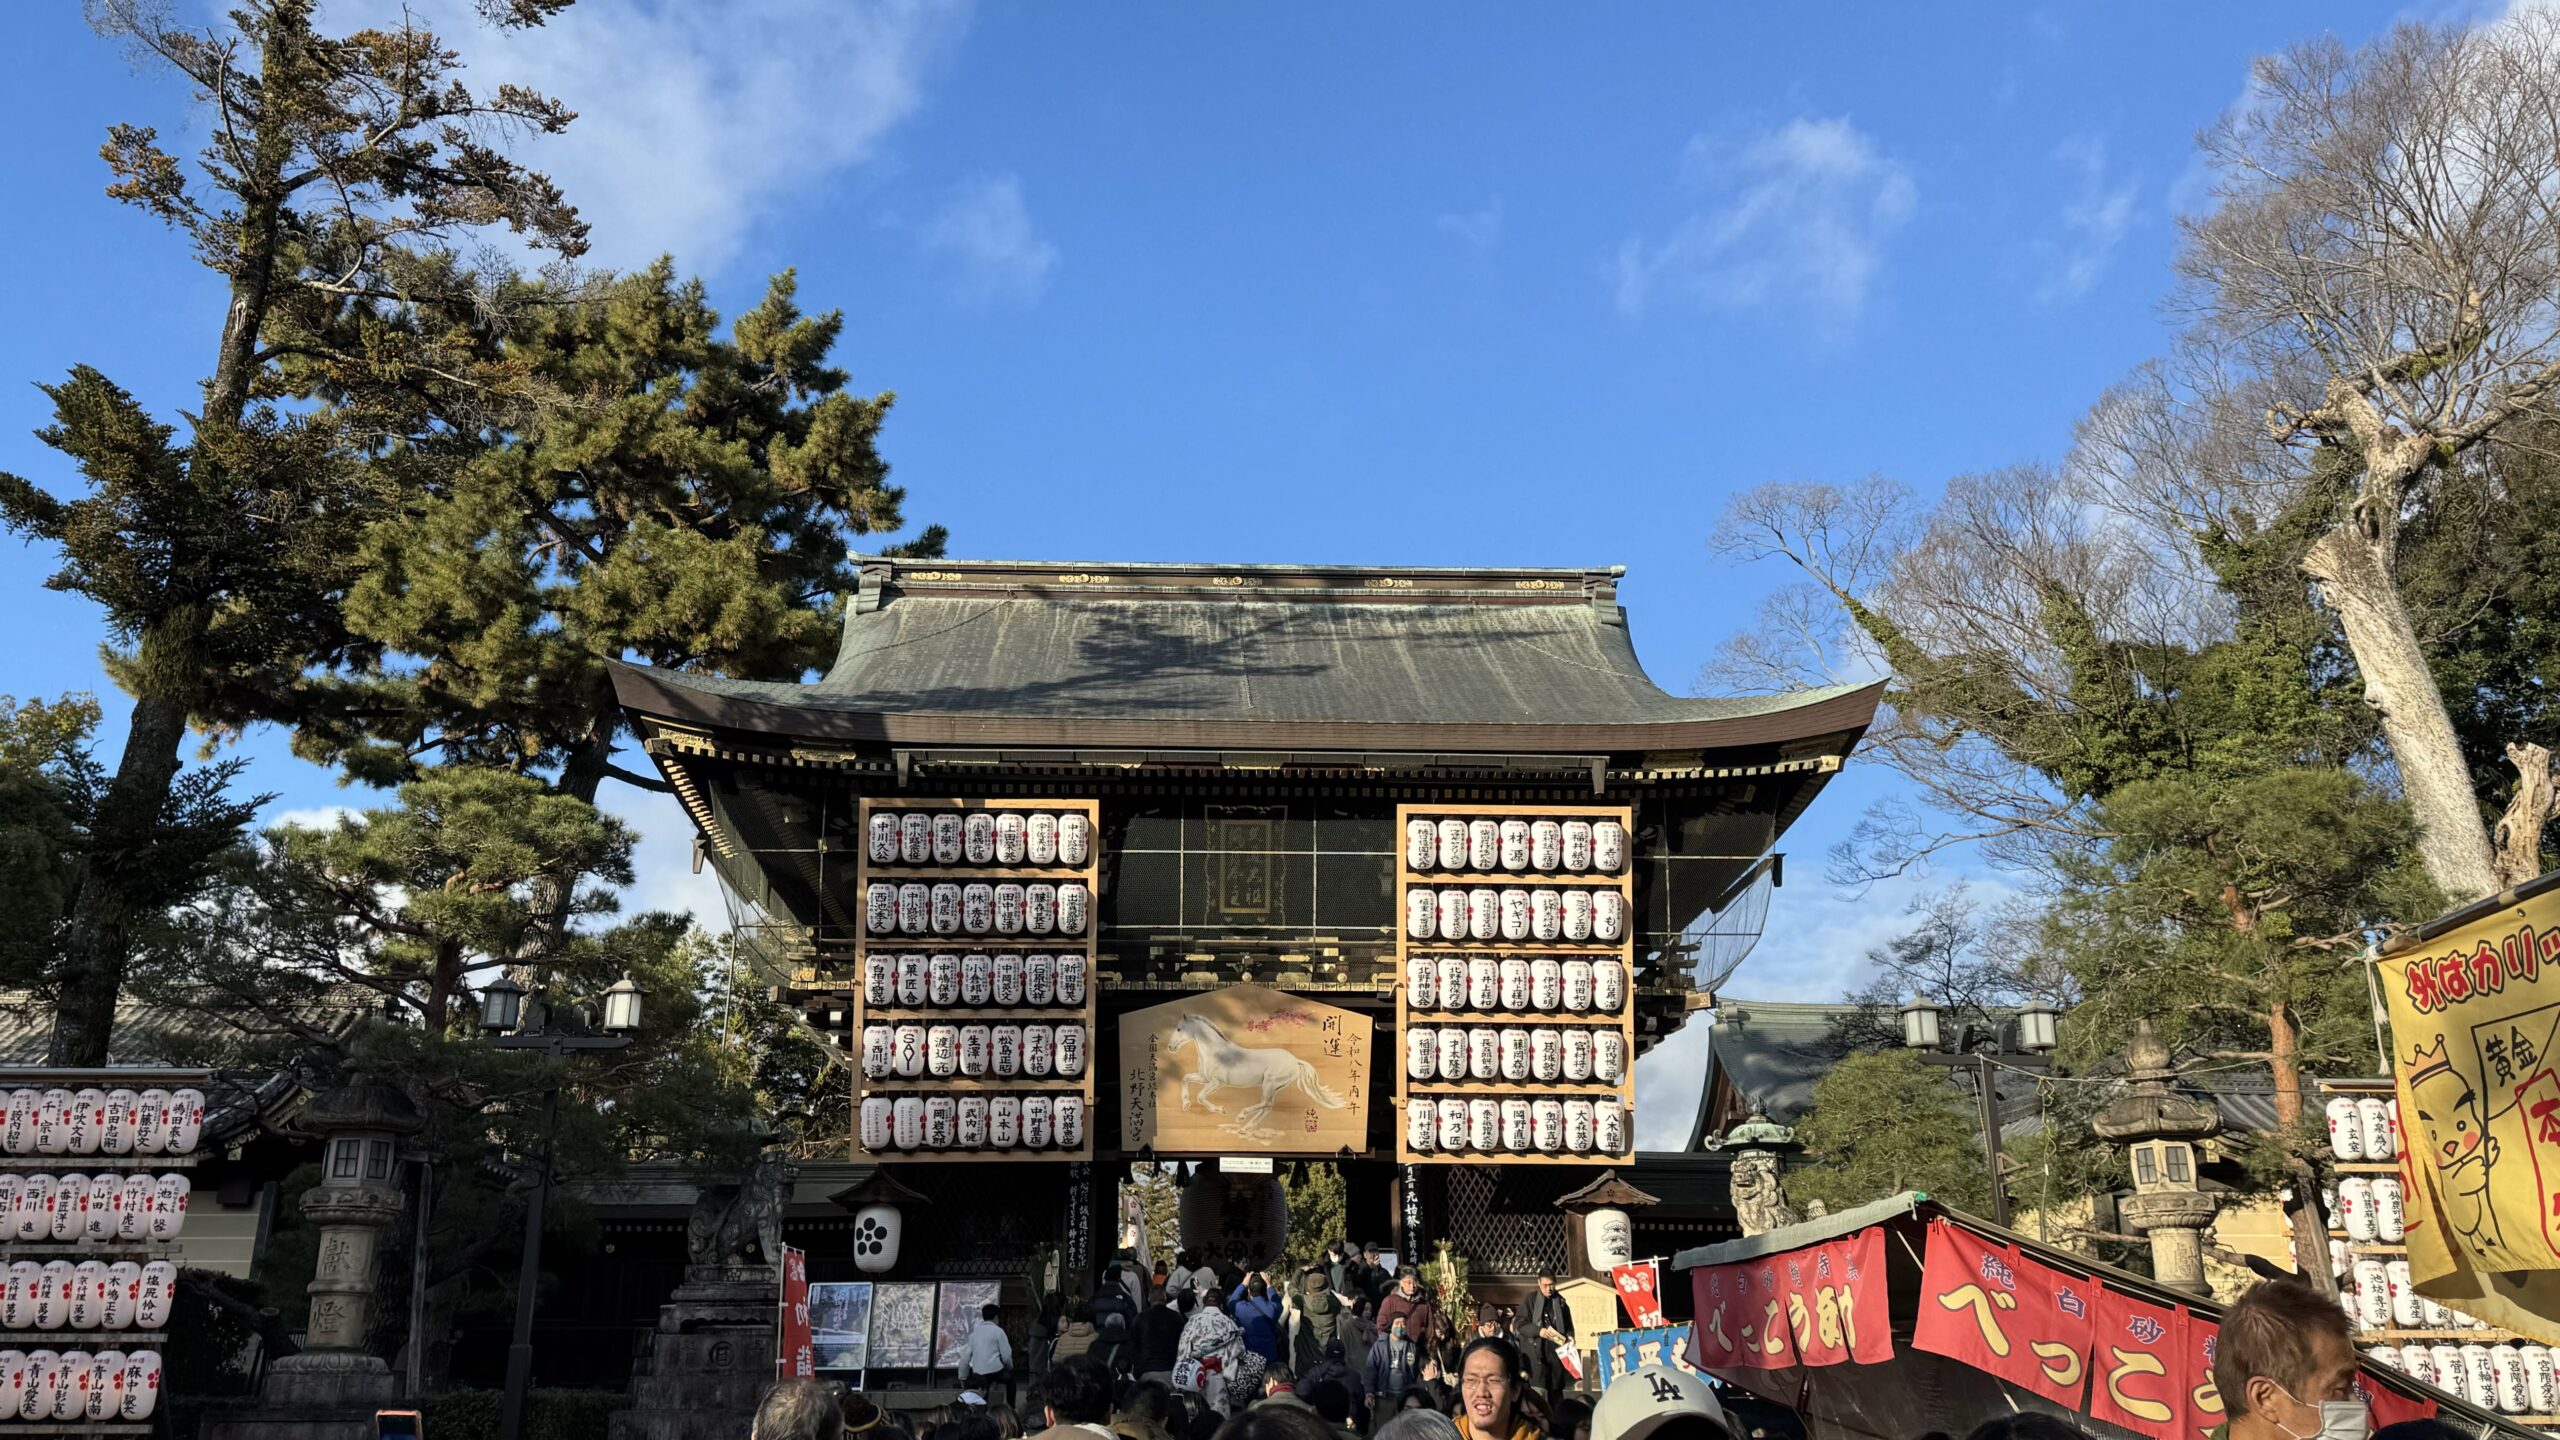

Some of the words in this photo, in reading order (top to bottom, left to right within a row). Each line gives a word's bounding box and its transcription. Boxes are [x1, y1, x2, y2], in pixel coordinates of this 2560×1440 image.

[1603, 848, 1618, 867] 老松
[1605, 917, 1616, 935] もり
[1323, 1015, 1343, 1058] 開運
[2486, 1025, 2538, 1088] 黄金
[1346, 1033, 1363, 1115] 令和八年丙午
[70, 1102, 91, 1148] 伊吹文明
[997, 1107, 1011, 1142] 山本山
[1129, 1067, 1145, 1142] 北野天満宮
[1644, 1372, 1684, 1402] LA
